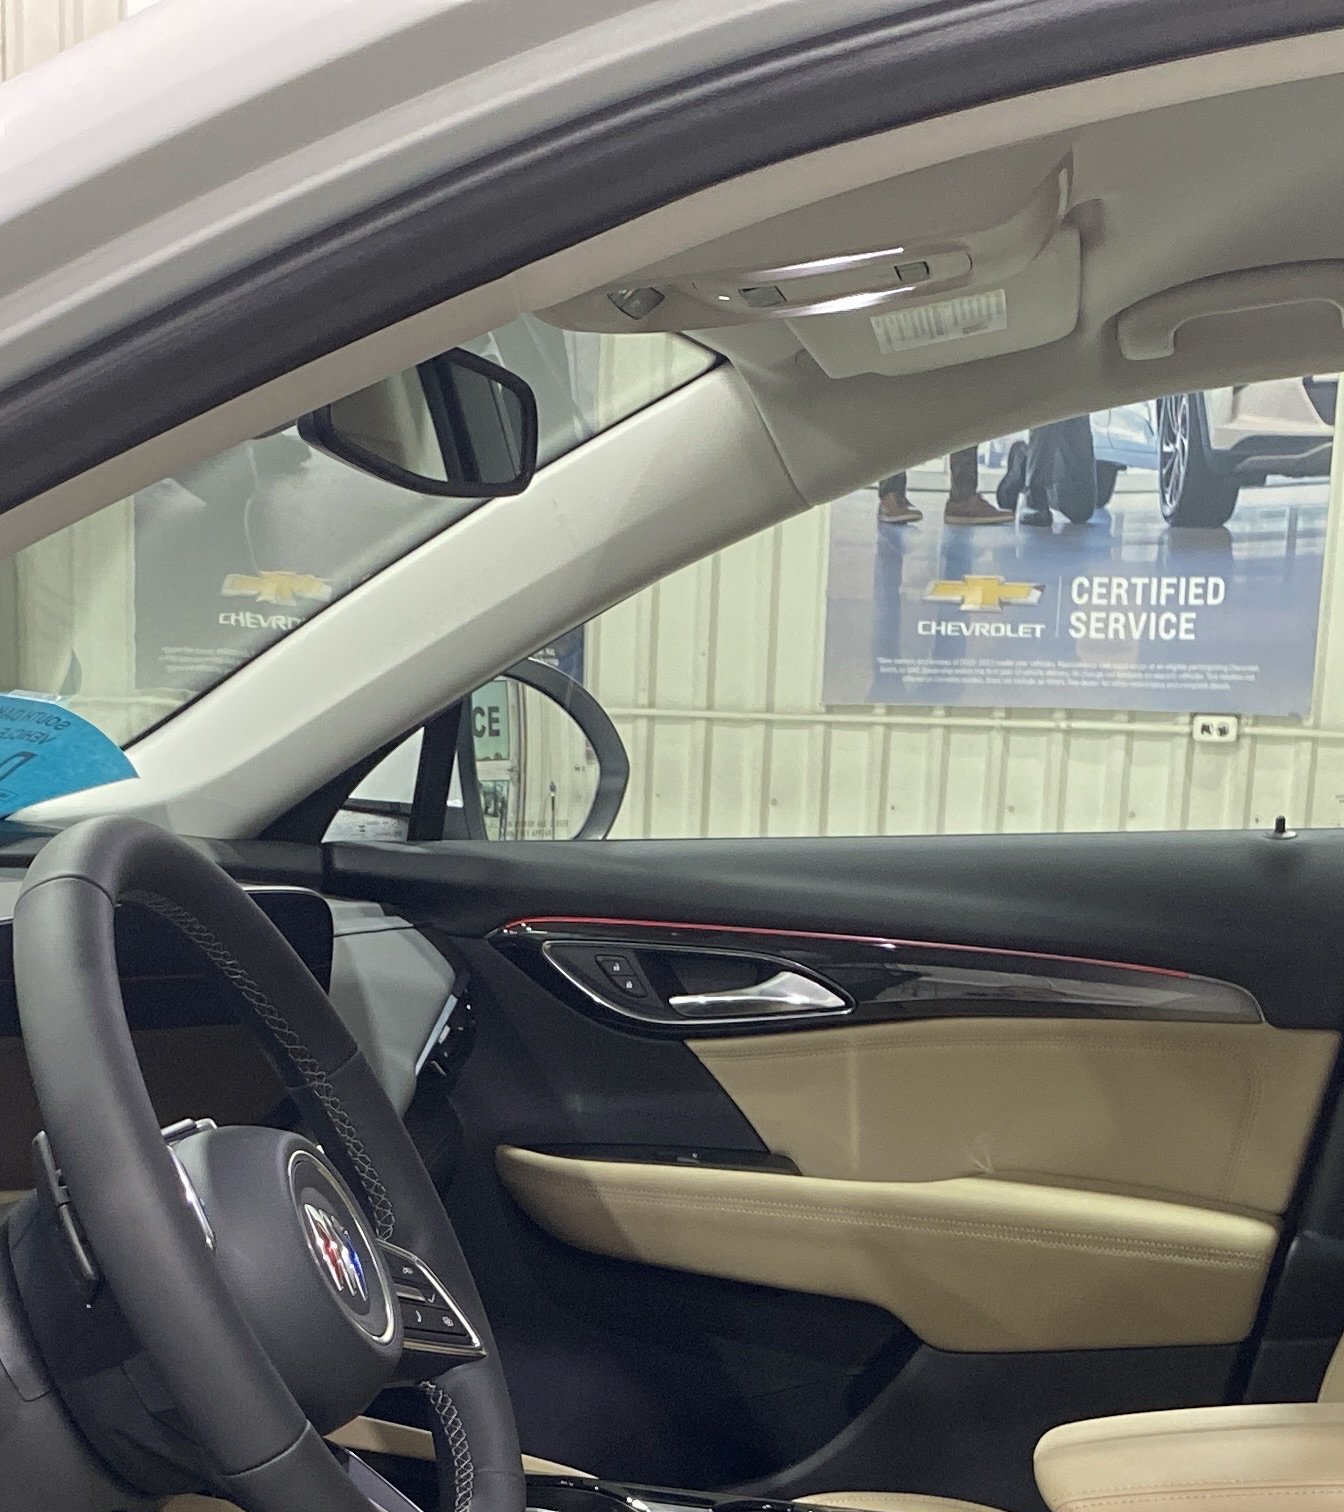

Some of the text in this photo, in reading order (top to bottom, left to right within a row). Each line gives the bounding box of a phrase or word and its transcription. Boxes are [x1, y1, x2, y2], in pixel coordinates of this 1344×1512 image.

[1070, 576, 1225, 606] CERTIFIED
[917, 620, 1045, 638] CHEVROLET
[1068, 612, 1197, 640] SERVICE
